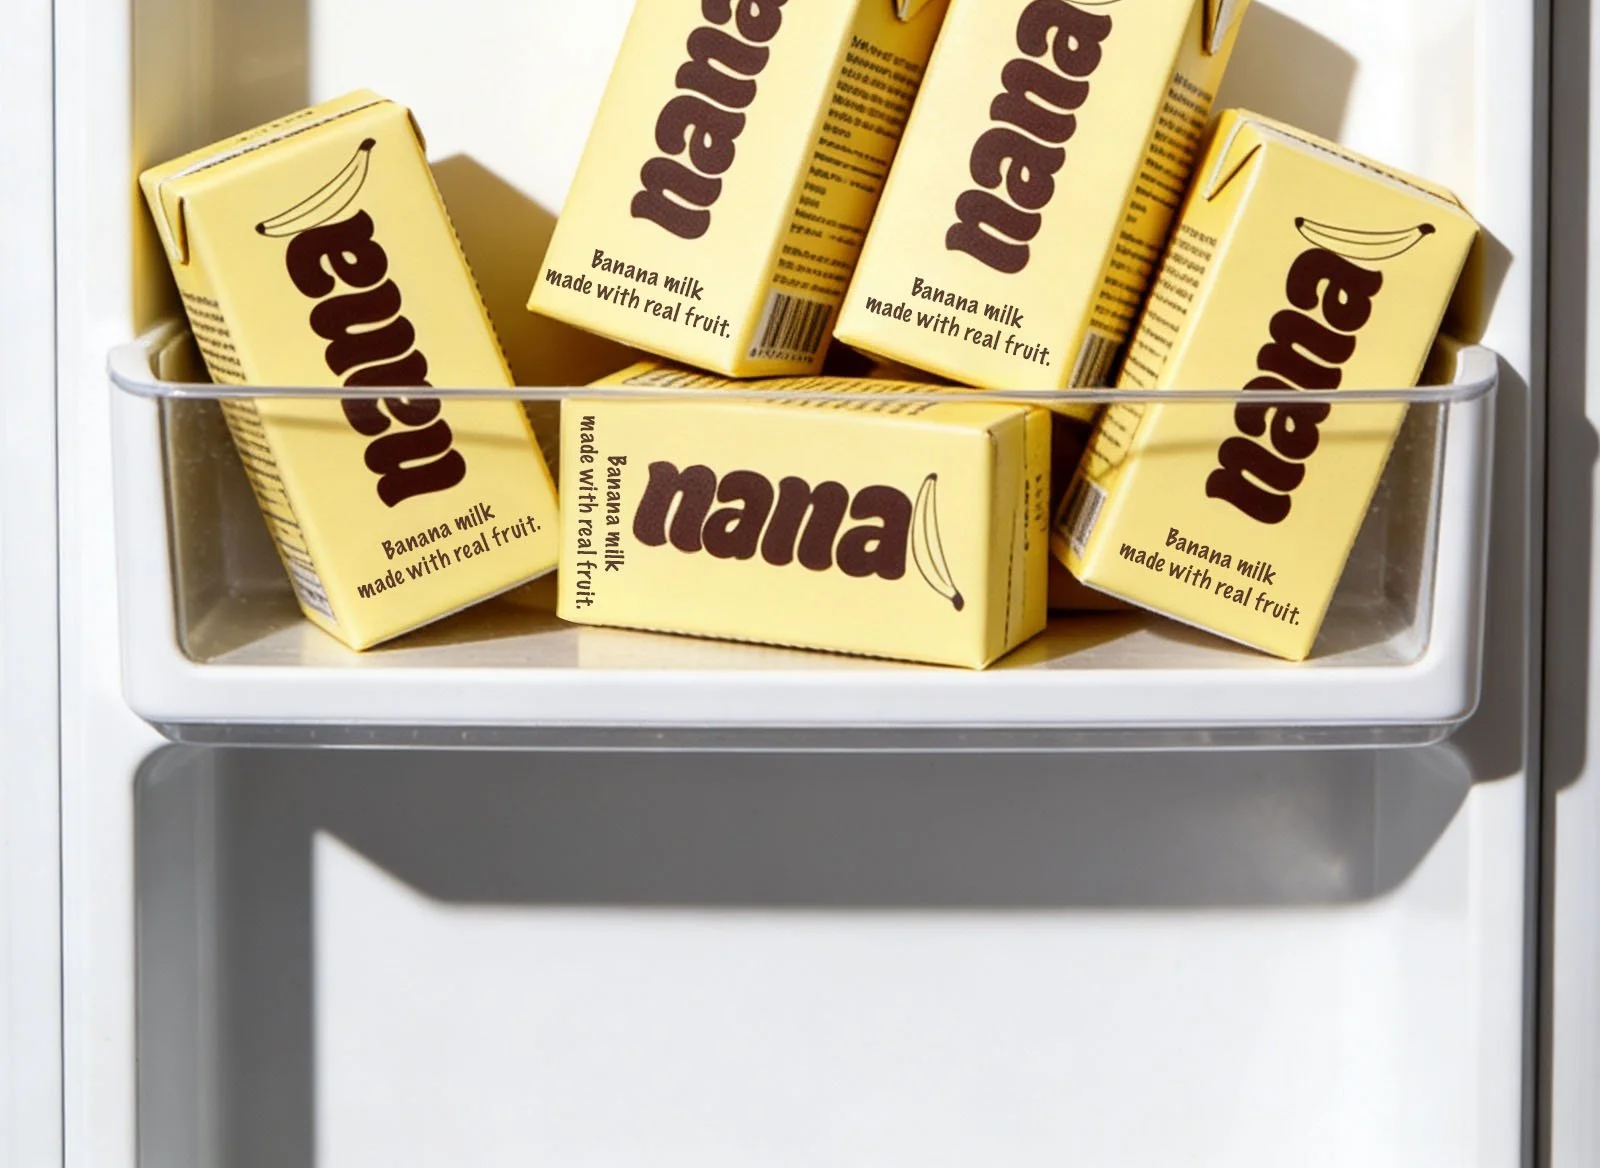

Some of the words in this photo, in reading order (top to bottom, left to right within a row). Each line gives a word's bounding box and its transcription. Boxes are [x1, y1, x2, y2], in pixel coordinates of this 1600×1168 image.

[545, 268, 593, 295] made
[597, 283, 640, 309] with
[643, 299, 682, 322] real
[685, 306, 730, 339] fruit.
[591, 248, 659, 287] Banana
[663, 275, 704, 301] milk
[911, 276, 979, 315] Banana
[983, 303, 1024, 329] milk
[286, 208, 467, 509] nana
[865, 296, 913, 323] made
[917, 311, 960, 337] with
[963, 327, 1002, 351] real
[1004, 334, 1050, 367] fruit.
[1206, 247, 1383, 525] nana
[579, 415, 599, 464] made
[578, 468, 599, 513] with
[605, 455, 627, 526] Banana
[381, 523, 453, 560] Banana
[454, 502, 496, 531] milk
[576, 519, 598, 555] real
[633, 460, 913, 581] nana
[357, 569, 406, 599] made
[405, 548, 452, 580] with
[453, 532, 491, 563] real
[491, 515, 541, 547] fruit.
[604, 531, 625, 572] milk
[1165, 527, 1232, 569] Banana
[1236, 559, 1277, 586] milk
[575, 560, 598, 609] fruit.
[1119, 543, 1166, 572] made
[1168, 561, 1212, 590] with
[1214, 581, 1254, 607] real
[1254, 591, 1300, 626] fruit.
